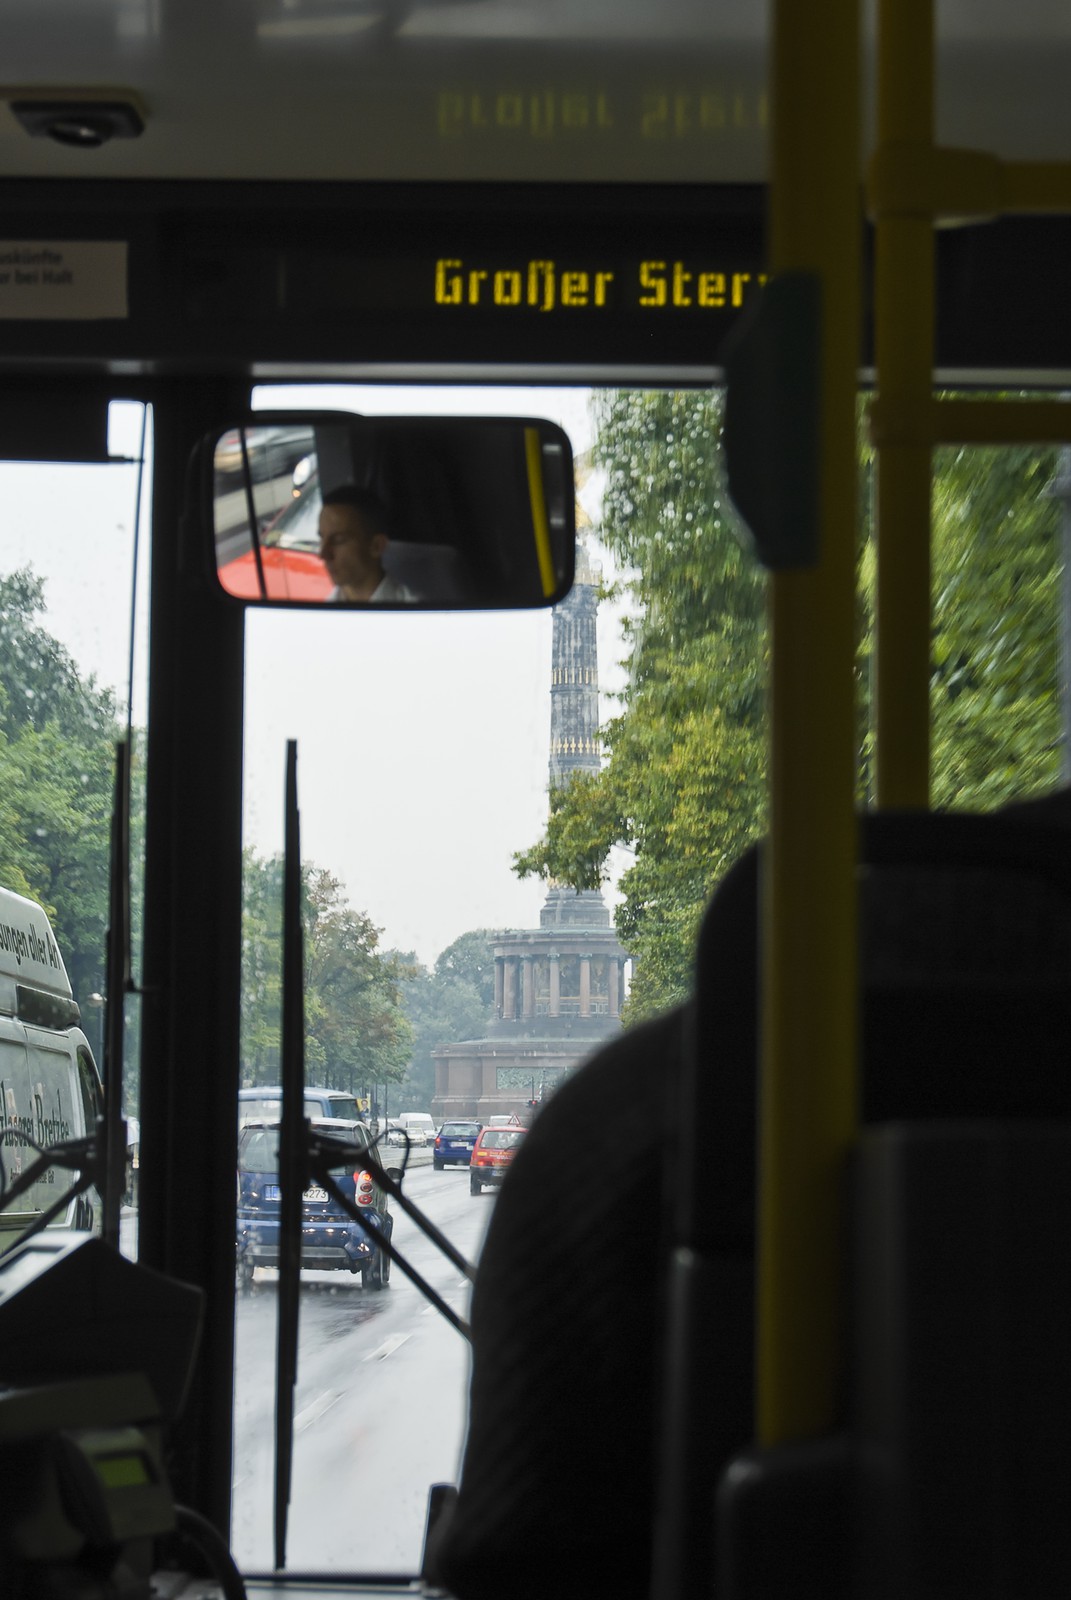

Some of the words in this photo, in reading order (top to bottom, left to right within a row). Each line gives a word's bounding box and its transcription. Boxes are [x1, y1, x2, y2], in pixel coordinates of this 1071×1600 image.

[435, 259, 614, 311] Großer
[639, 261, 769, 308] Ster
[0, 1080, 35, 1147] laserei
[303, 1189, 327, 1199] 4273
